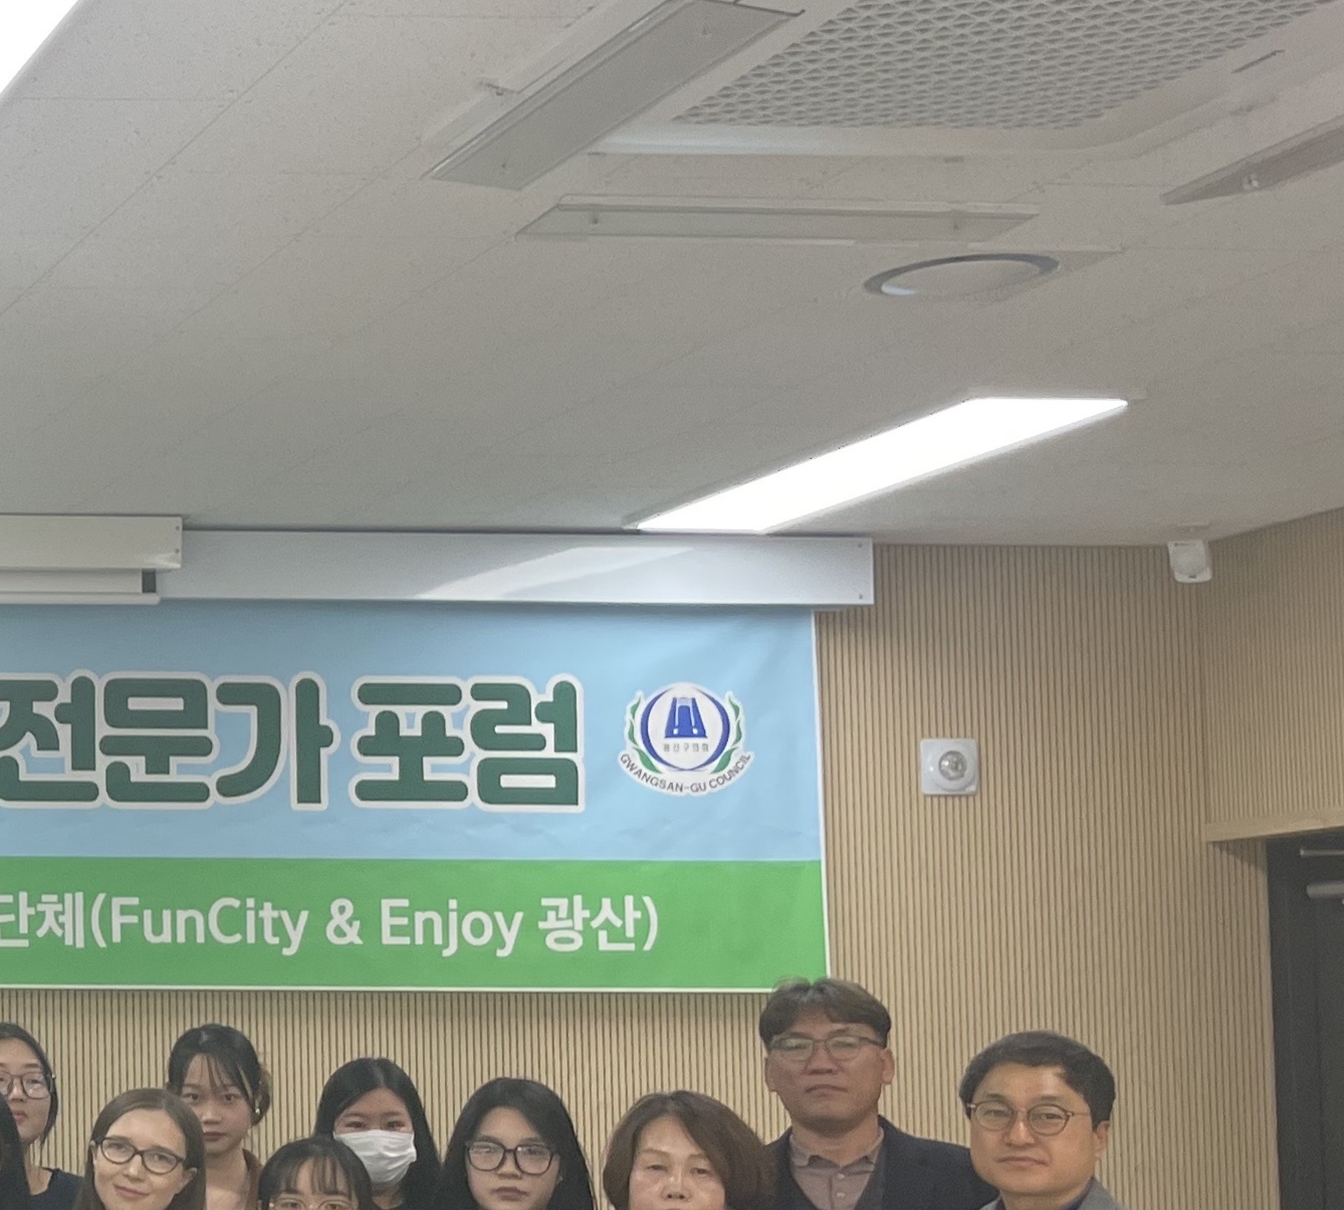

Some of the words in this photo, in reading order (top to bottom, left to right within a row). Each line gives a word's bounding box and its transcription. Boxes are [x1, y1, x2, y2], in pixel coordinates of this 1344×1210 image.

[354, 678, 580, 808] 포럼
[619, 753, 707, 793] GWANGSAN-GU
[708, 753, 752, 790] COUNCIL
[325, 898, 363, 946] &
[380, 898, 524, 957] Enjoy
[538, 893, 660, 954] 광산)
